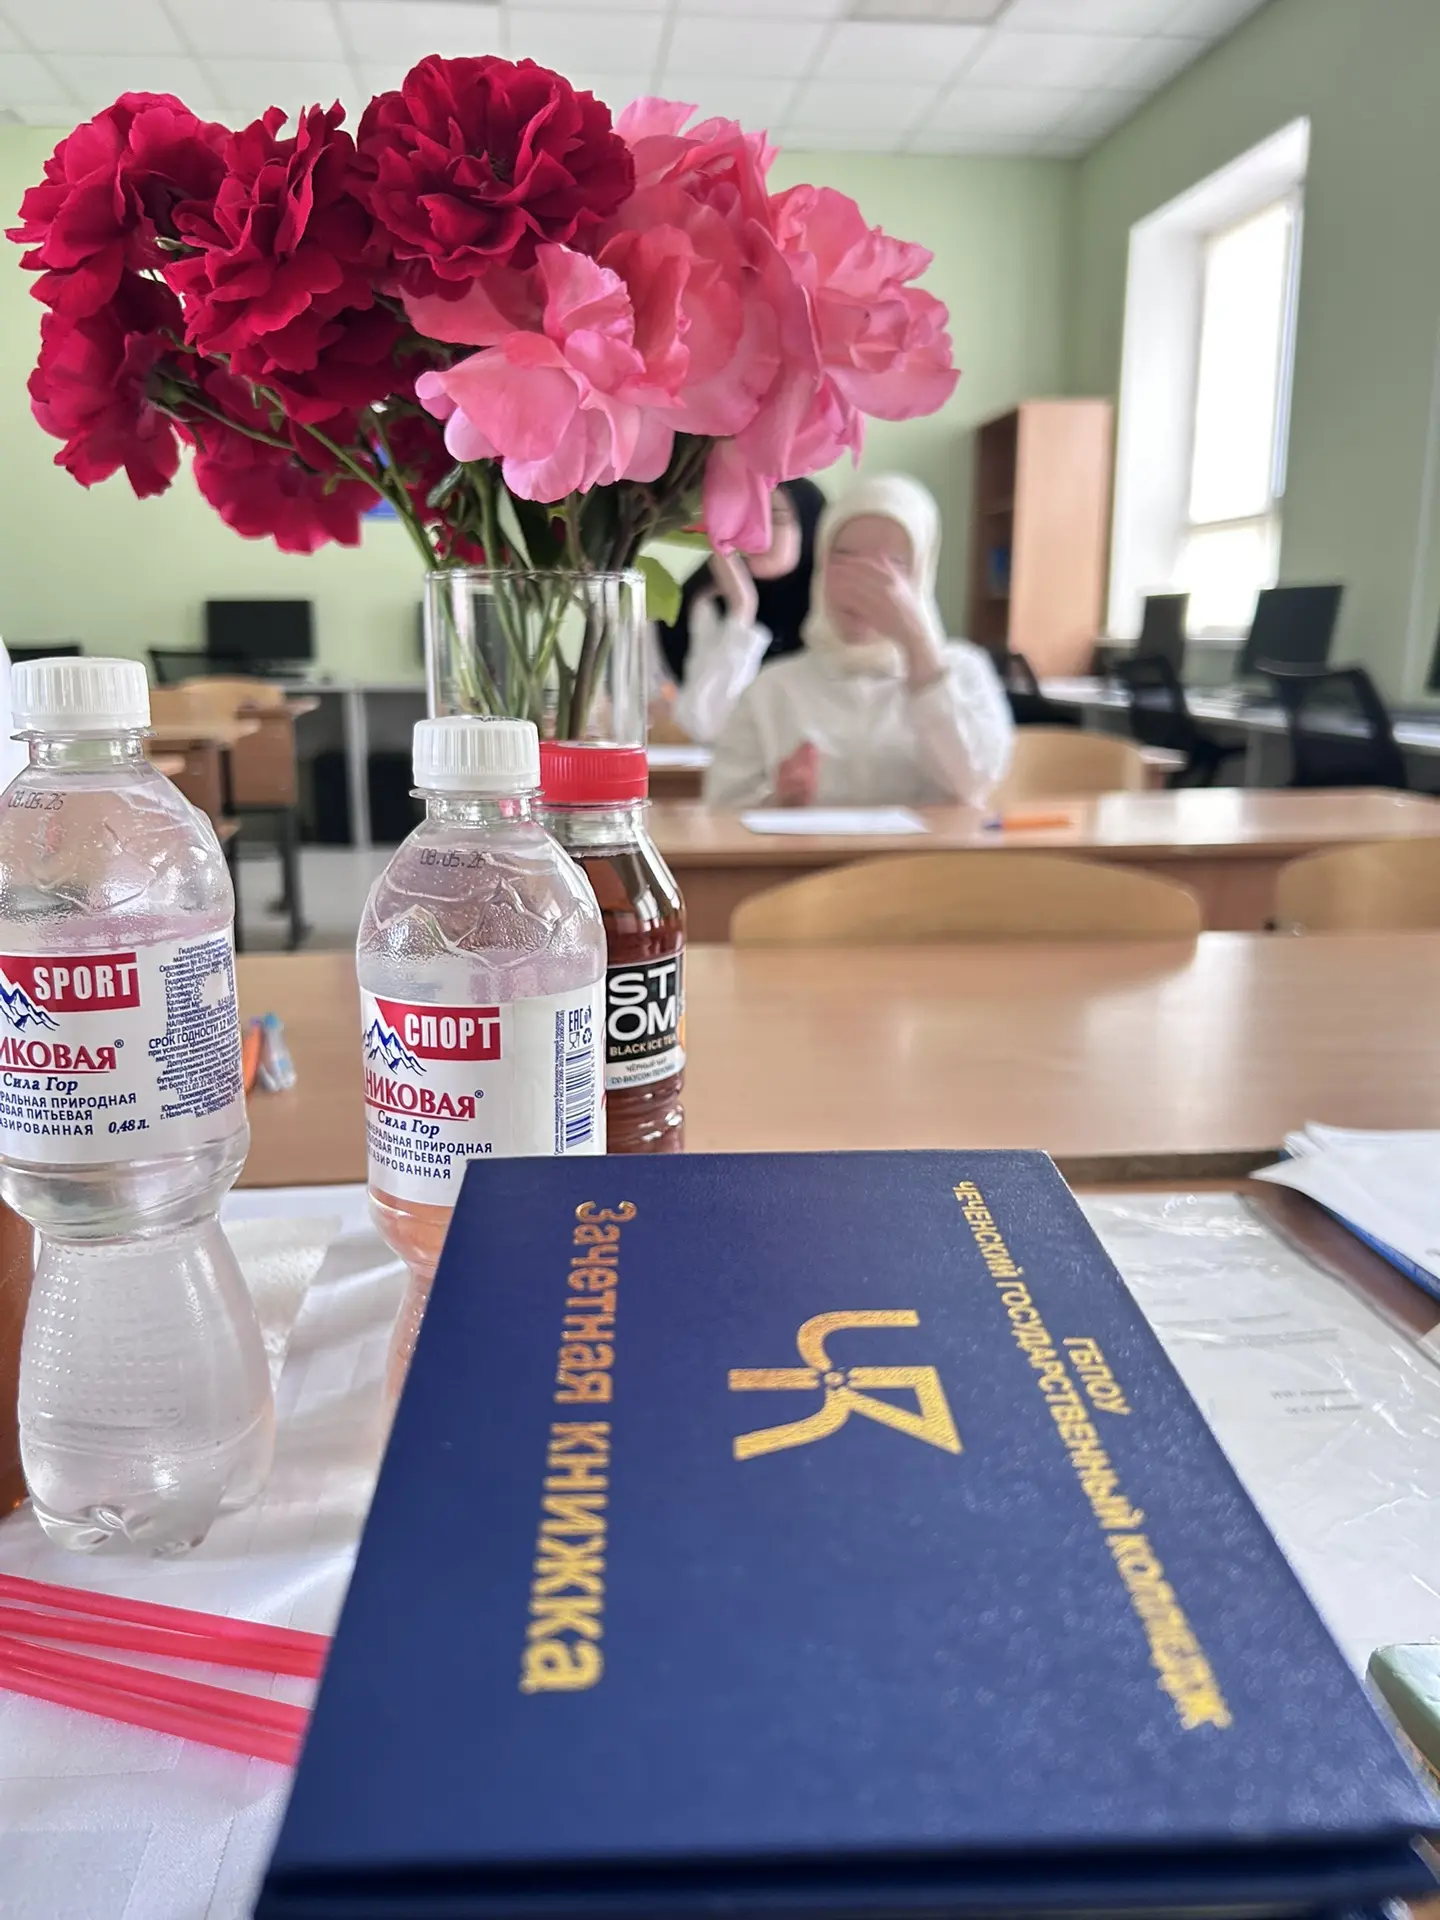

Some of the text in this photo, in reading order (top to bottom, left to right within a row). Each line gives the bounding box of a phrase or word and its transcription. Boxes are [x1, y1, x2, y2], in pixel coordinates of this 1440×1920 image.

[33, 962, 137, 1000] SPORT
[149, 1035, 176, 1049] СРОК
[177, 1023, 219, 1043] ГОДНОСТИ
[404, 1012, 500, 1049] СПОРТ
[609, 1042, 647, 1057] BLACK
[3, 1072, 78, 1095] Сила Гор
[52, 1093, 137, 1109] ПРИРОДНАЯ
[27, 1108, 93, 1120] ПИТЬЕВАЯ
[378, 1110, 440, 1139] Сила Гор
[108, 1119, 150, 1134] 0,48 л.
[394, 1146, 451, 1165] ПИТЬЕВАЯ
[415, 1140, 492, 1156] ПРИРОДНАЯ
[952, 1181, 1024, 1283] ЧЕЧЕНСКИЙ
[998, 1279, 1145, 1528] ГОСУДАРСТВЕННЫЙ
[1062, 1336, 1131, 1415] ГБПОУ
[517, 1199, 637, 1694] Зачетная книжка
